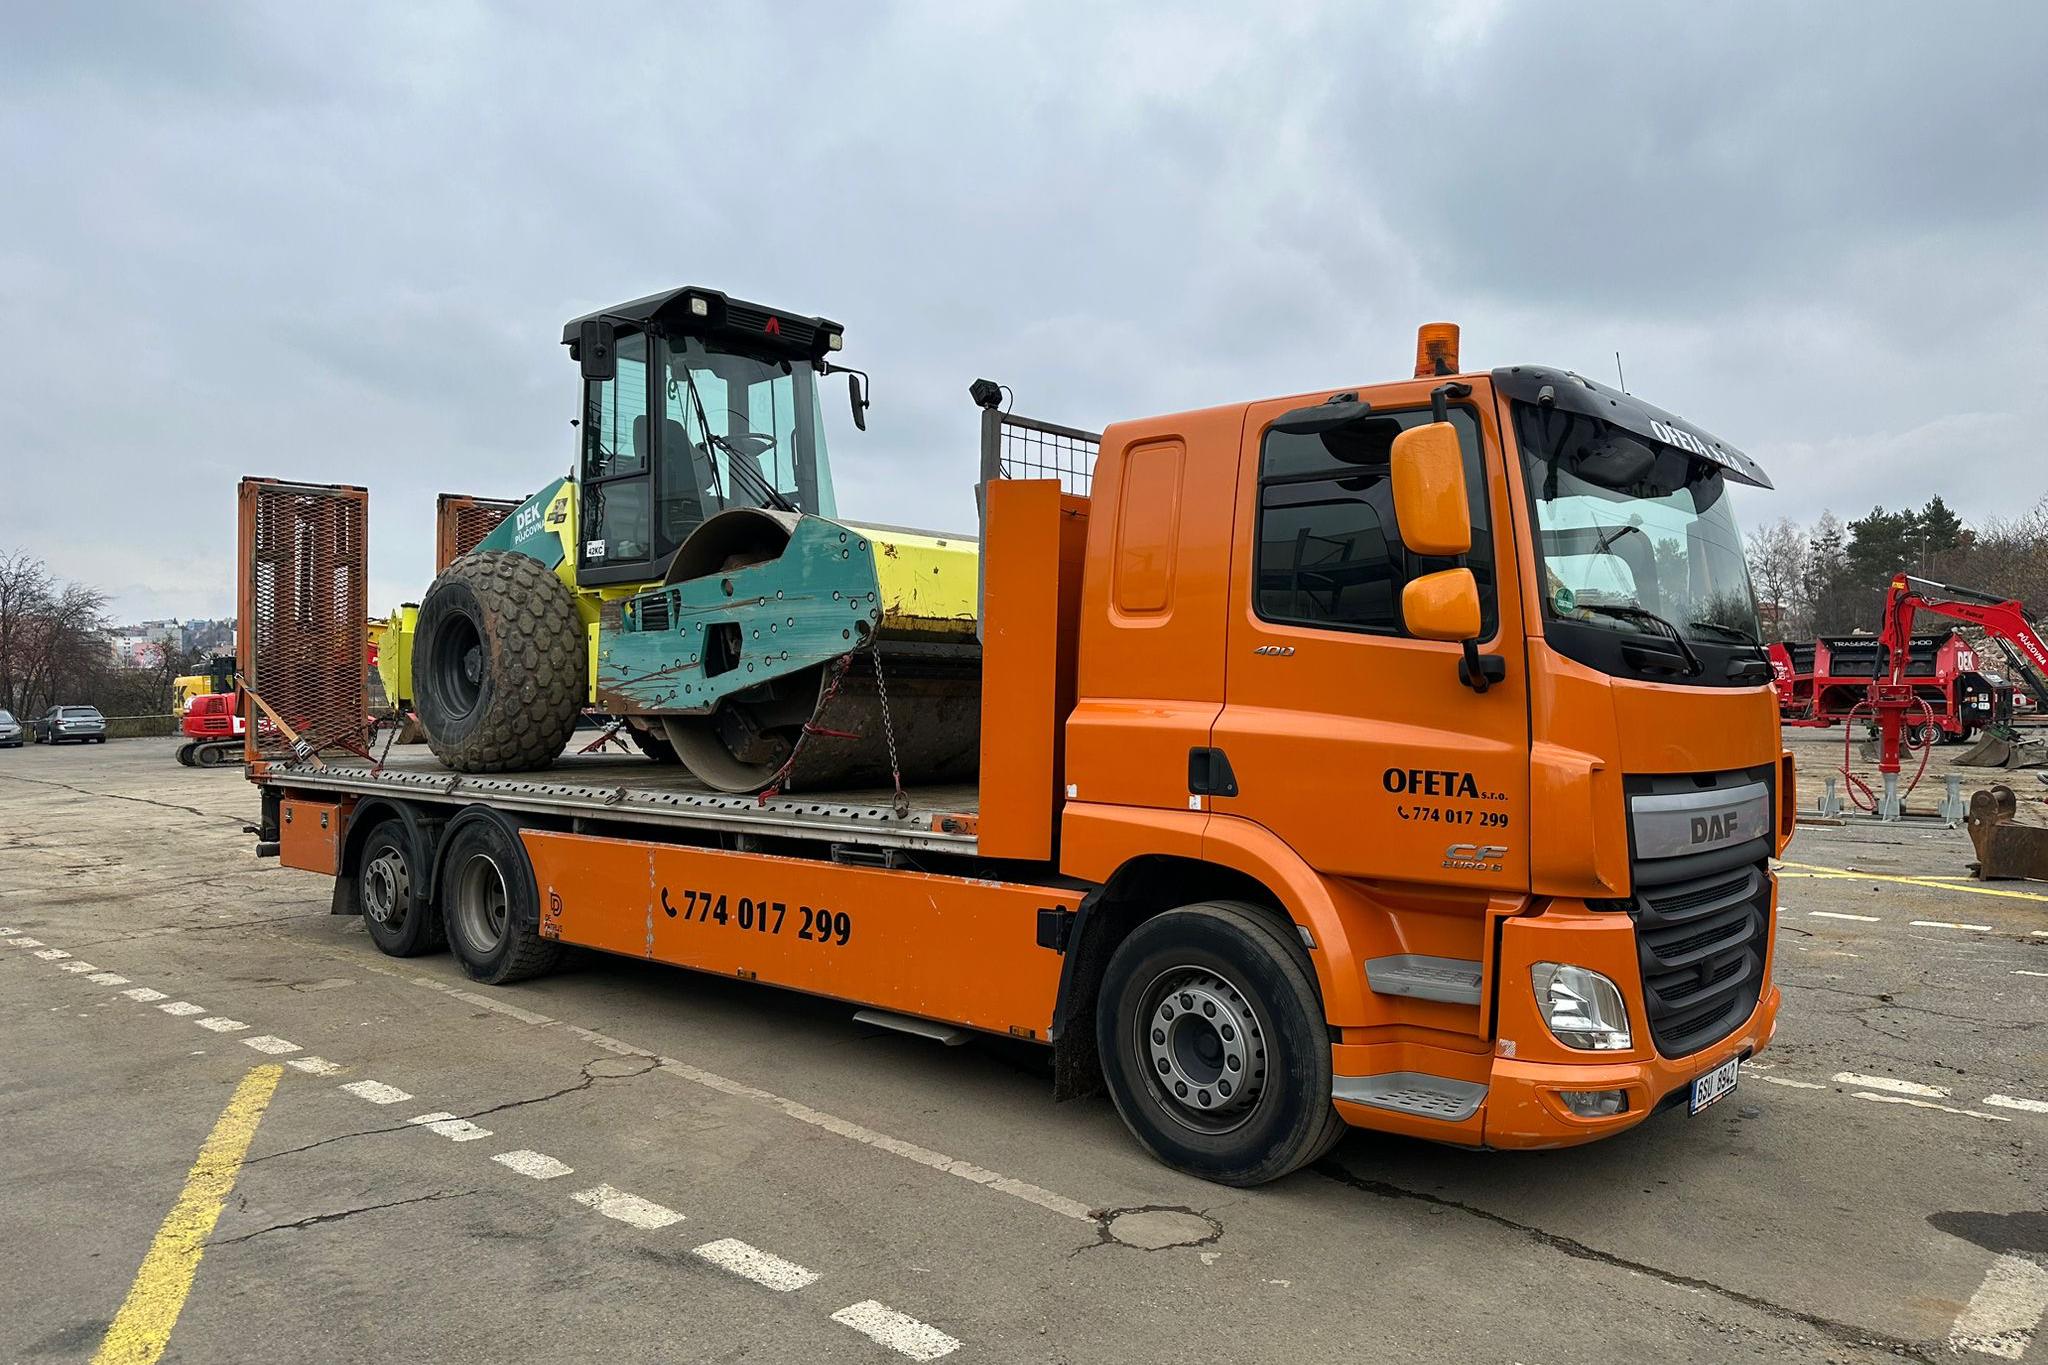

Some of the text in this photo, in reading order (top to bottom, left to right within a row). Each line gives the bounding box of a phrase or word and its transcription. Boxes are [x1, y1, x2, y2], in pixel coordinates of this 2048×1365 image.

[1649, 419, 1712, 458] OFETA
[516, 502, 541, 531] DEK
[1254, 645, 1295, 656] 400
[1957, 651, 1976, 671] DEK
[2016, 632, 2047, 666] PŮJČOVNA
[1382, 767, 1509, 801] OFETA s.r.o.
[1413, 806, 1509, 828] 774 017 299
[1691, 811, 1738, 844] DAF
[1441, 860, 1488, 872] EURO
[1446, 843, 1509, 861] CF
[684, 890, 851, 946] 774 017 299
[1697, 1074, 1714, 1103] 6SU
